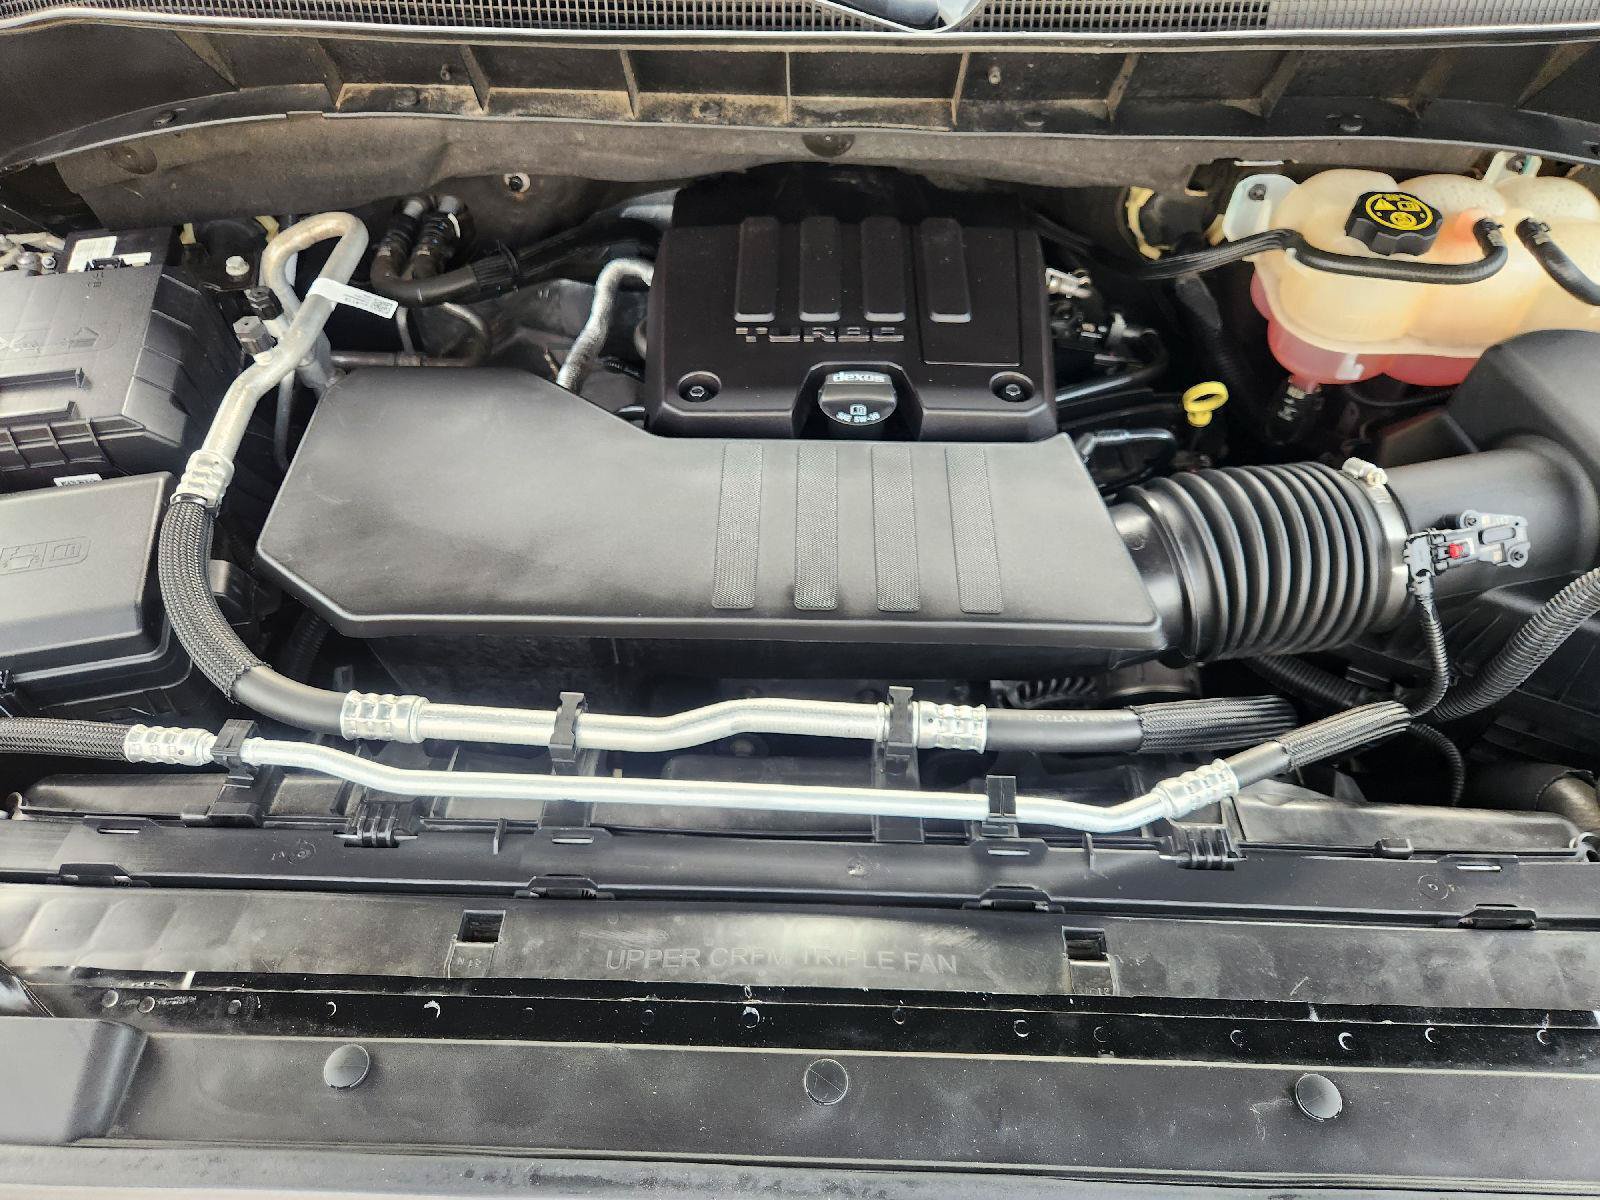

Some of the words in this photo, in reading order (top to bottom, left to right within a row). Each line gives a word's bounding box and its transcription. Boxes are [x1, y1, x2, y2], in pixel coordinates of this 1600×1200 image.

[832, 371, 885, 383] dexos
[605, 947, 703, 971] UPPER
[800, 946, 894, 971] TRIPLE
[903, 951, 958, 975] FAN
